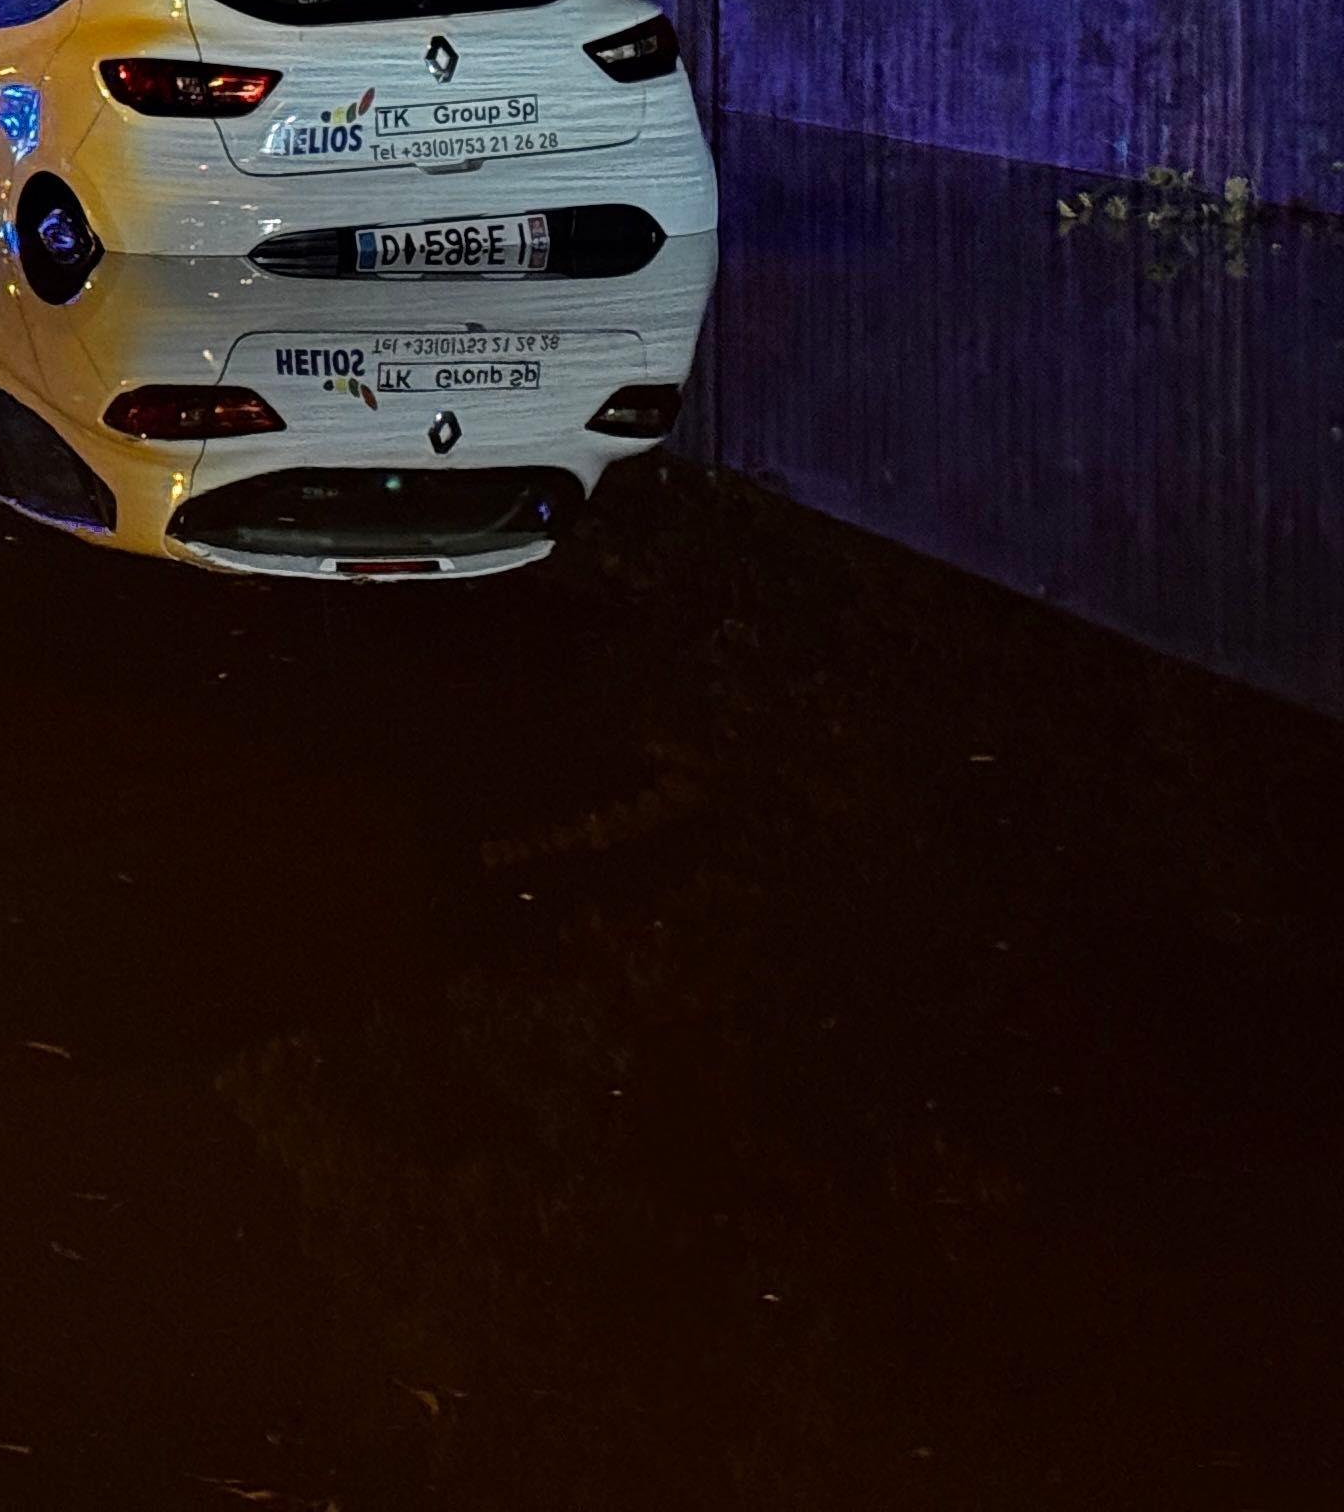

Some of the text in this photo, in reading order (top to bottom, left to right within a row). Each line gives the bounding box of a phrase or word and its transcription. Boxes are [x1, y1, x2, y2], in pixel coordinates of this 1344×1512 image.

[379, 98, 535, 129] TK Group Sp
[370, 132, 559, 161] Tel +33(0)753 21 26 28
